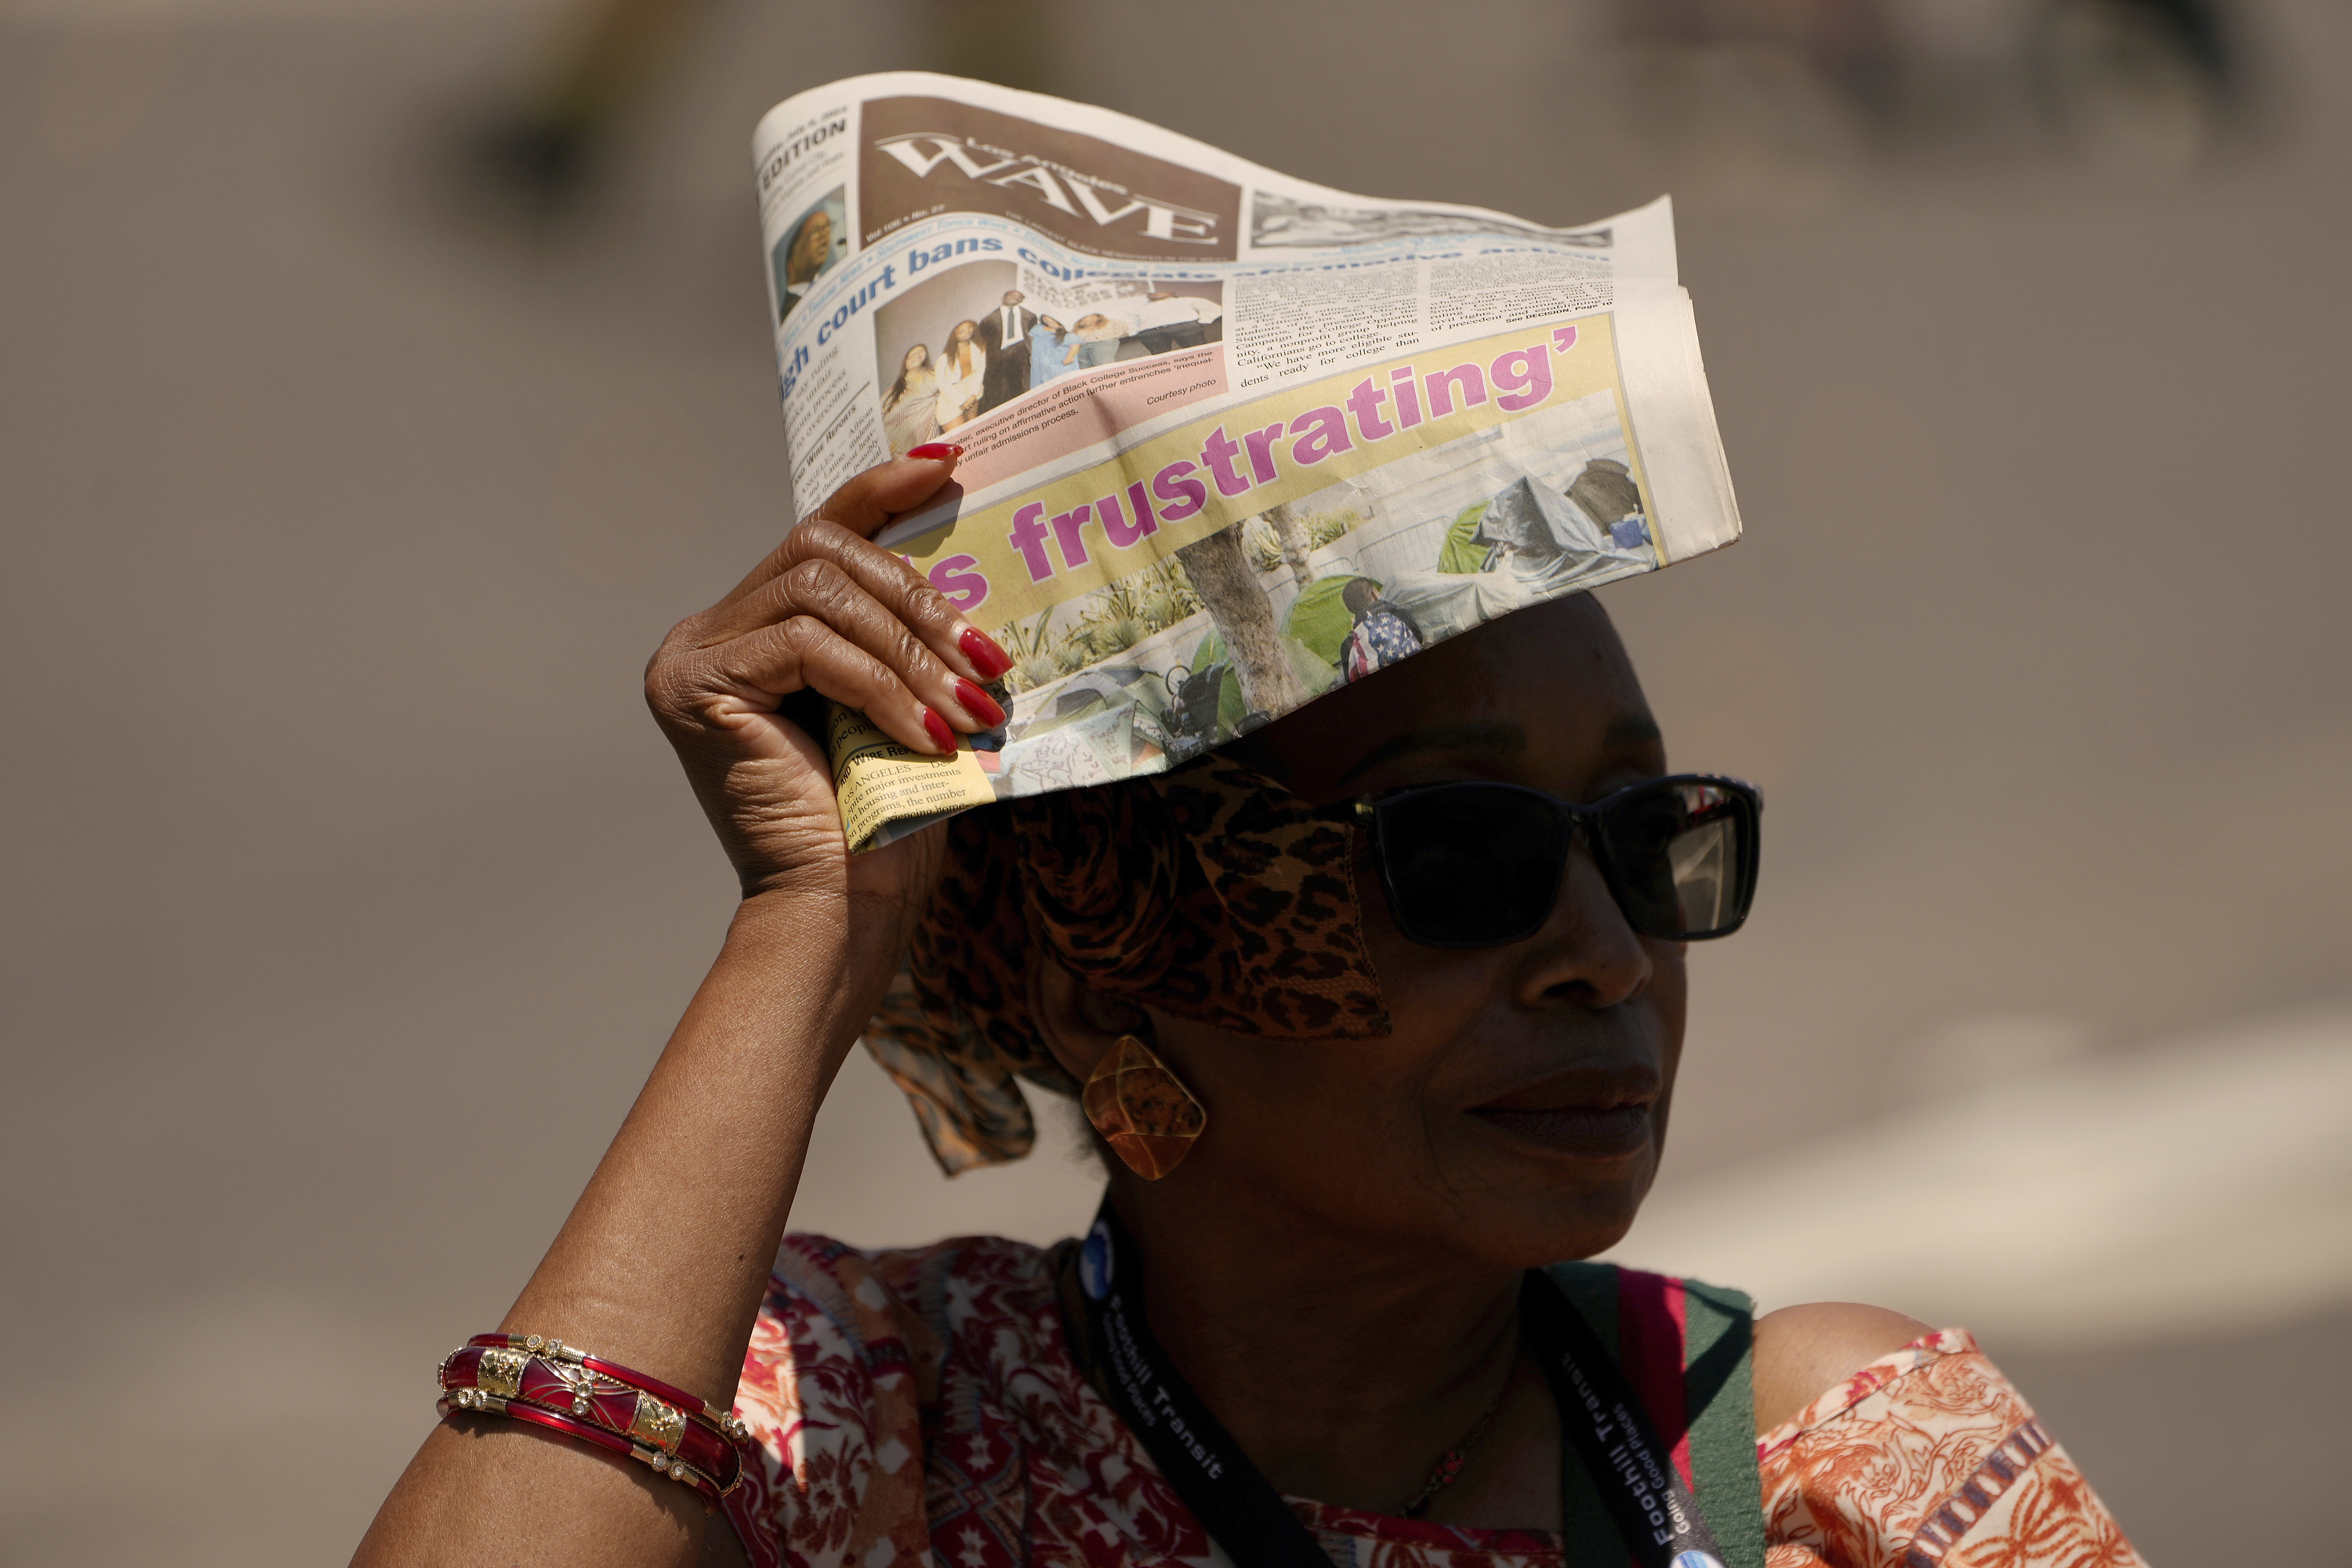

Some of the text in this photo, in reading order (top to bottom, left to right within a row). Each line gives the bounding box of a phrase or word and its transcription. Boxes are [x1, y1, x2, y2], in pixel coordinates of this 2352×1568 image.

[762, 118, 846, 191] EDITION
[966, 136, 1129, 196] Los Angeles
[874, 132, 1219, 245] WAVE
[781, 345, 808, 402] gh
[817, 264, 895, 346] court
[909, 237, 1003, 275] bans
[1236, 336, 1292, 350] Campaign
[1319, 322, 1361, 333] College
[1367, 314, 1417, 325] Opportu-
[1323, 315, 1373, 328] president
[1449, 315, 1501, 329] precedent
[1526, 308, 1572, 320] DECISION,
[1237, 349, 1260, 358] nity,
[1280, 334, 1330, 349] nonprofit
[1338, 327, 1370, 338] group
[1377, 318, 1417, 329] helping
[1237, 347, 1305, 367] Californians
[1308, 343, 1322, 352] go
[1339, 332, 1383, 344] college.
[1287, 354, 1312, 365] have
[1318, 346, 1346, 358] more
[1352, 336, 1392, 349] eligible
[1240, 337, 1420, 388] dents ready for college than
[806, 382, 848, 437] overcome
[974, 431, 997, 451] ruling
[999, 426, 1010, 435] on
[1012, 404, 1057, 429] affirmative
[1058, 392, 1085, 408] action
[1086, 381, 1117, 397] further
[1120, 368, 1171, 386] entrenches
[975, 413, 1014, 436] executive
[1017, 397, 1050, 417] director
[1052, 390, 1061, 401] of
[1063, 380, 1087, 395] Black
[1091, 370, 1126, 385] College
[1128, 361, 1171, 375] Success,
[1174, 354, 1195, 365] says
[1147, 379, 1217, 405] Courtesy photo
[826, 405, 856, 444] REPORTS
[965, 446, 989, 463] unfair
[991, 426, 1040, 451] admissions
[1041, 409, 1079, 430] process.
[823, 453, 846, 480] Latino
[842, 450, 858, 471] most
[853, 437, 879, 473] possibly
[902, 552, 991, 614] s
[841, 766, 851, 789] AND
[851, 748, 884, 768] WIRE
[844, 790, 855, 805] OS
[854, 764, 912, 790] ANGELES
[848, 768, 961, 815] spite major investments
[850, 781, 949, 825] in housing and inter-
[858, 789, 967, 833] programs, the number
[936, 802, 970, 813] home-
[1152, 1384, 1225, 1480] Transit
[1613, 1402, 1691, 1535] Going Good Places
[1608, 1444, 1675, 1547] Foothill
